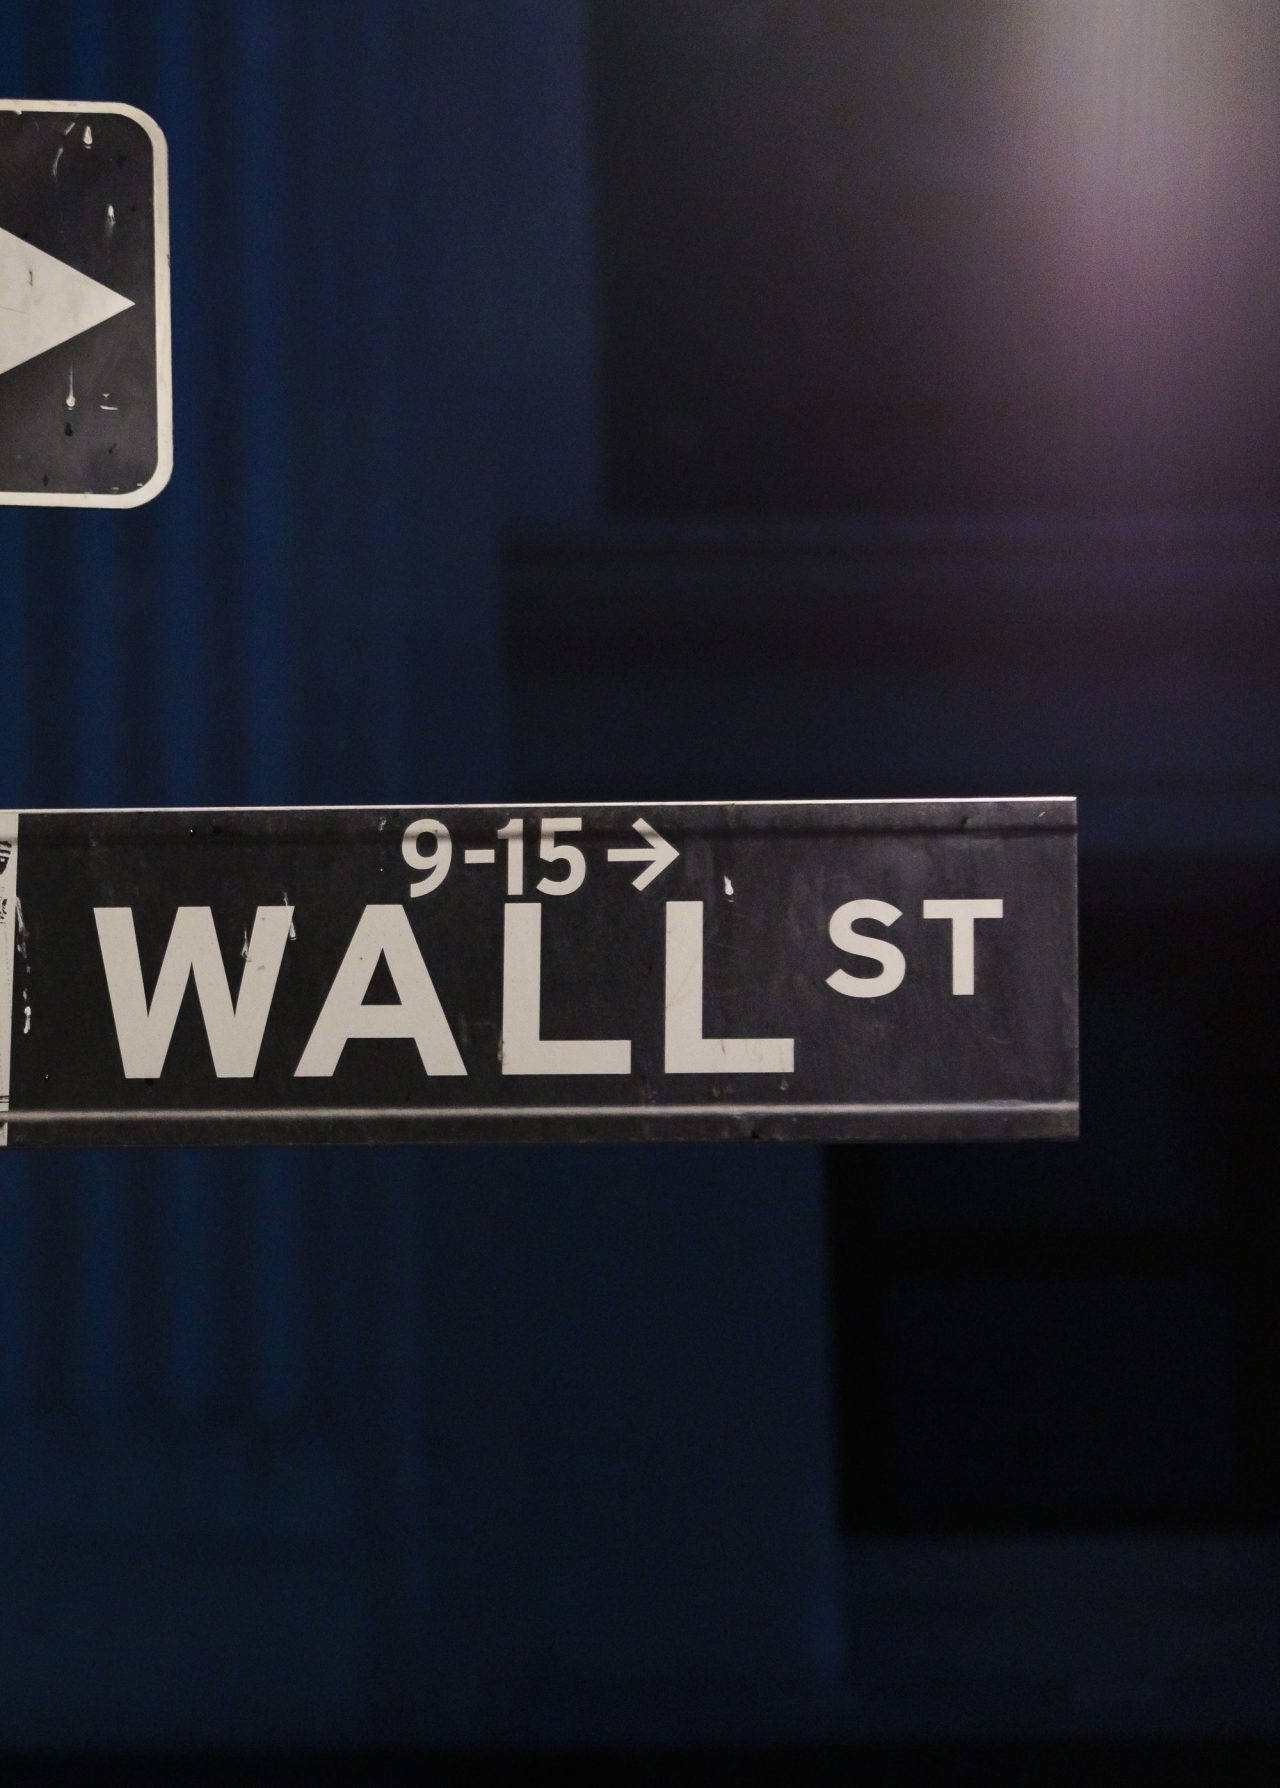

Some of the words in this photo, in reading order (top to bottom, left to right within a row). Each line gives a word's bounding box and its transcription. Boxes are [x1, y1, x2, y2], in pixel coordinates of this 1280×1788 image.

[400, 816, 588, 899] 9-15
[93, 900, 796, 1080] WALL
[824, 898, 1005, 998] ST
